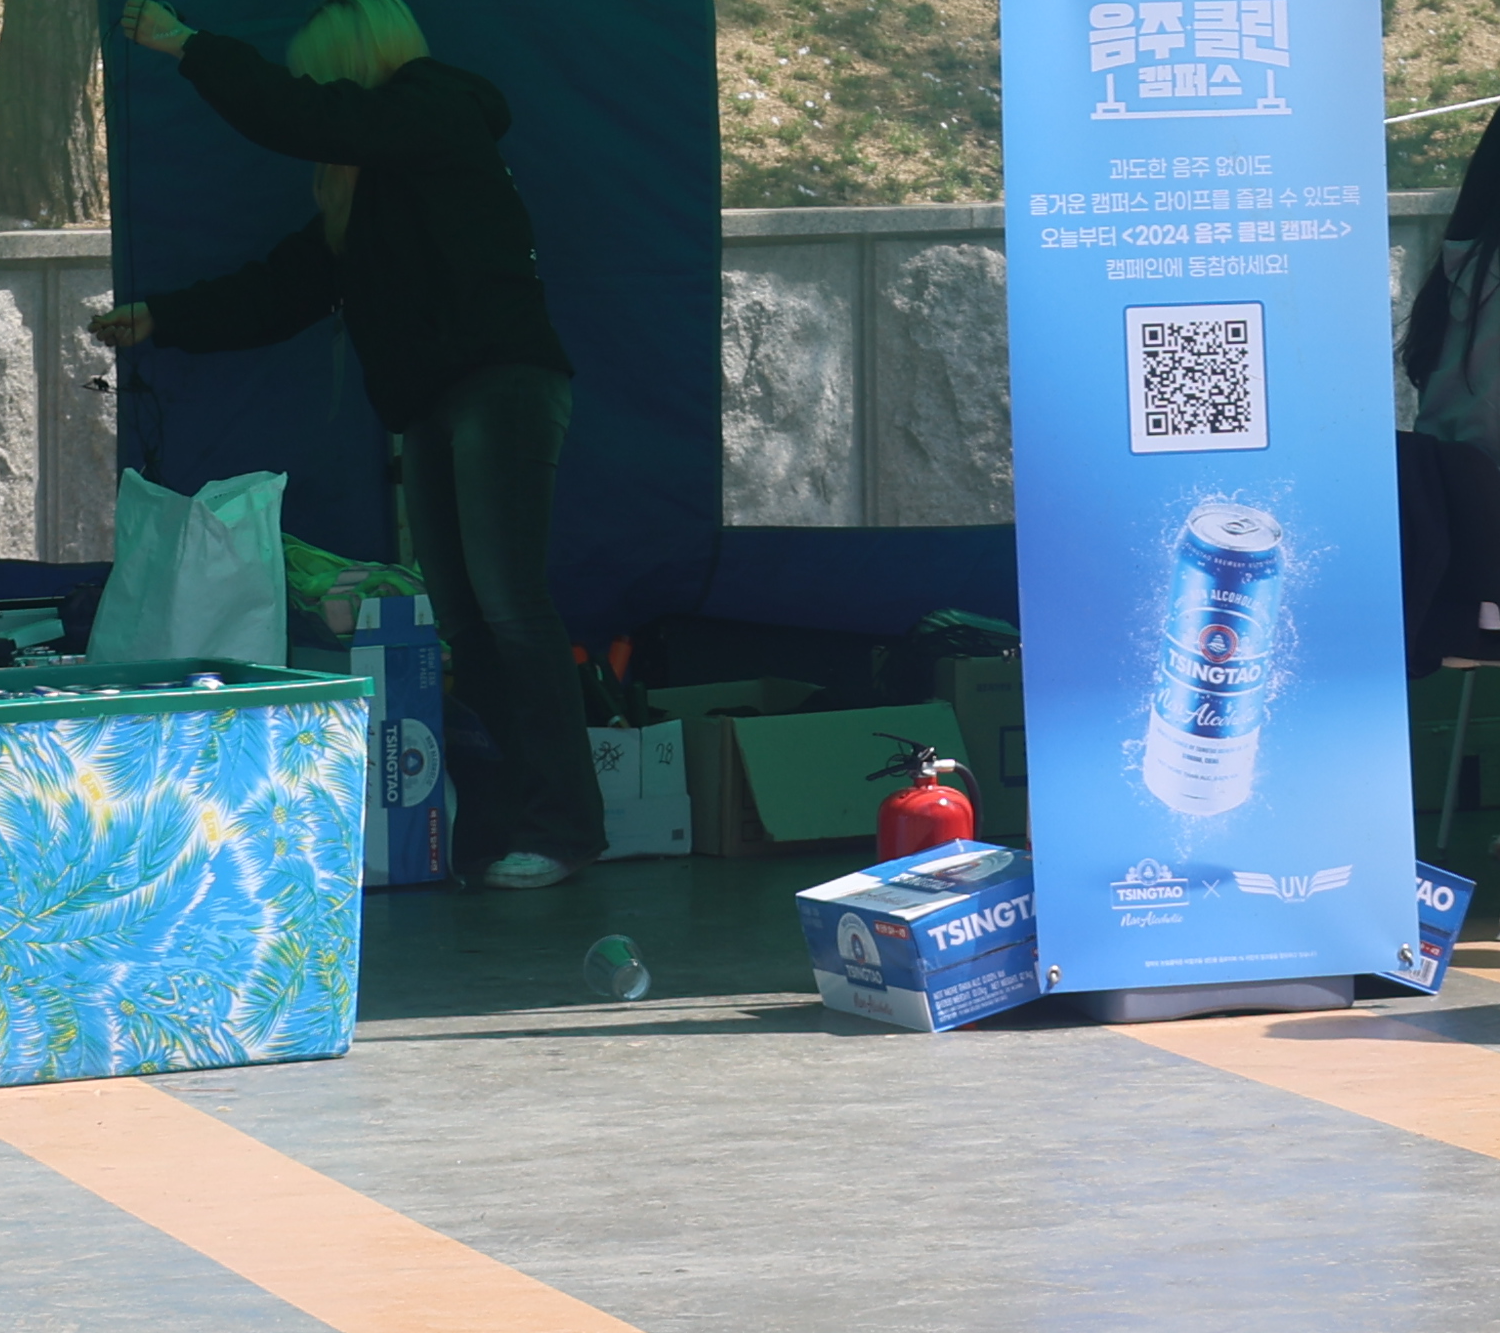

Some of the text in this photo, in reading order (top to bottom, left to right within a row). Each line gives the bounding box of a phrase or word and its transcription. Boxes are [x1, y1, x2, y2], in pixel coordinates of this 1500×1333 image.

[1138, 63, 1243, 98] 캠퍼스
[1109, 155, 1273, 180] 과도한 음주 없이도
[1030, 185, 1360, 215] 즐거운 캠퍼스 라이프를 즐길 수 있도록
[1041, 219, 1351, 248] 오늘부터 <2024 음주 클린 캠퍼스>
[1106, 254, 1288, 280] 캠페인에 동참하세요!
[1168, 647, 1262, 685] TSINGTAO
[1116, 885, 1184, 901] TSINGTAO
[1281, 876, 1308, 899] UV
